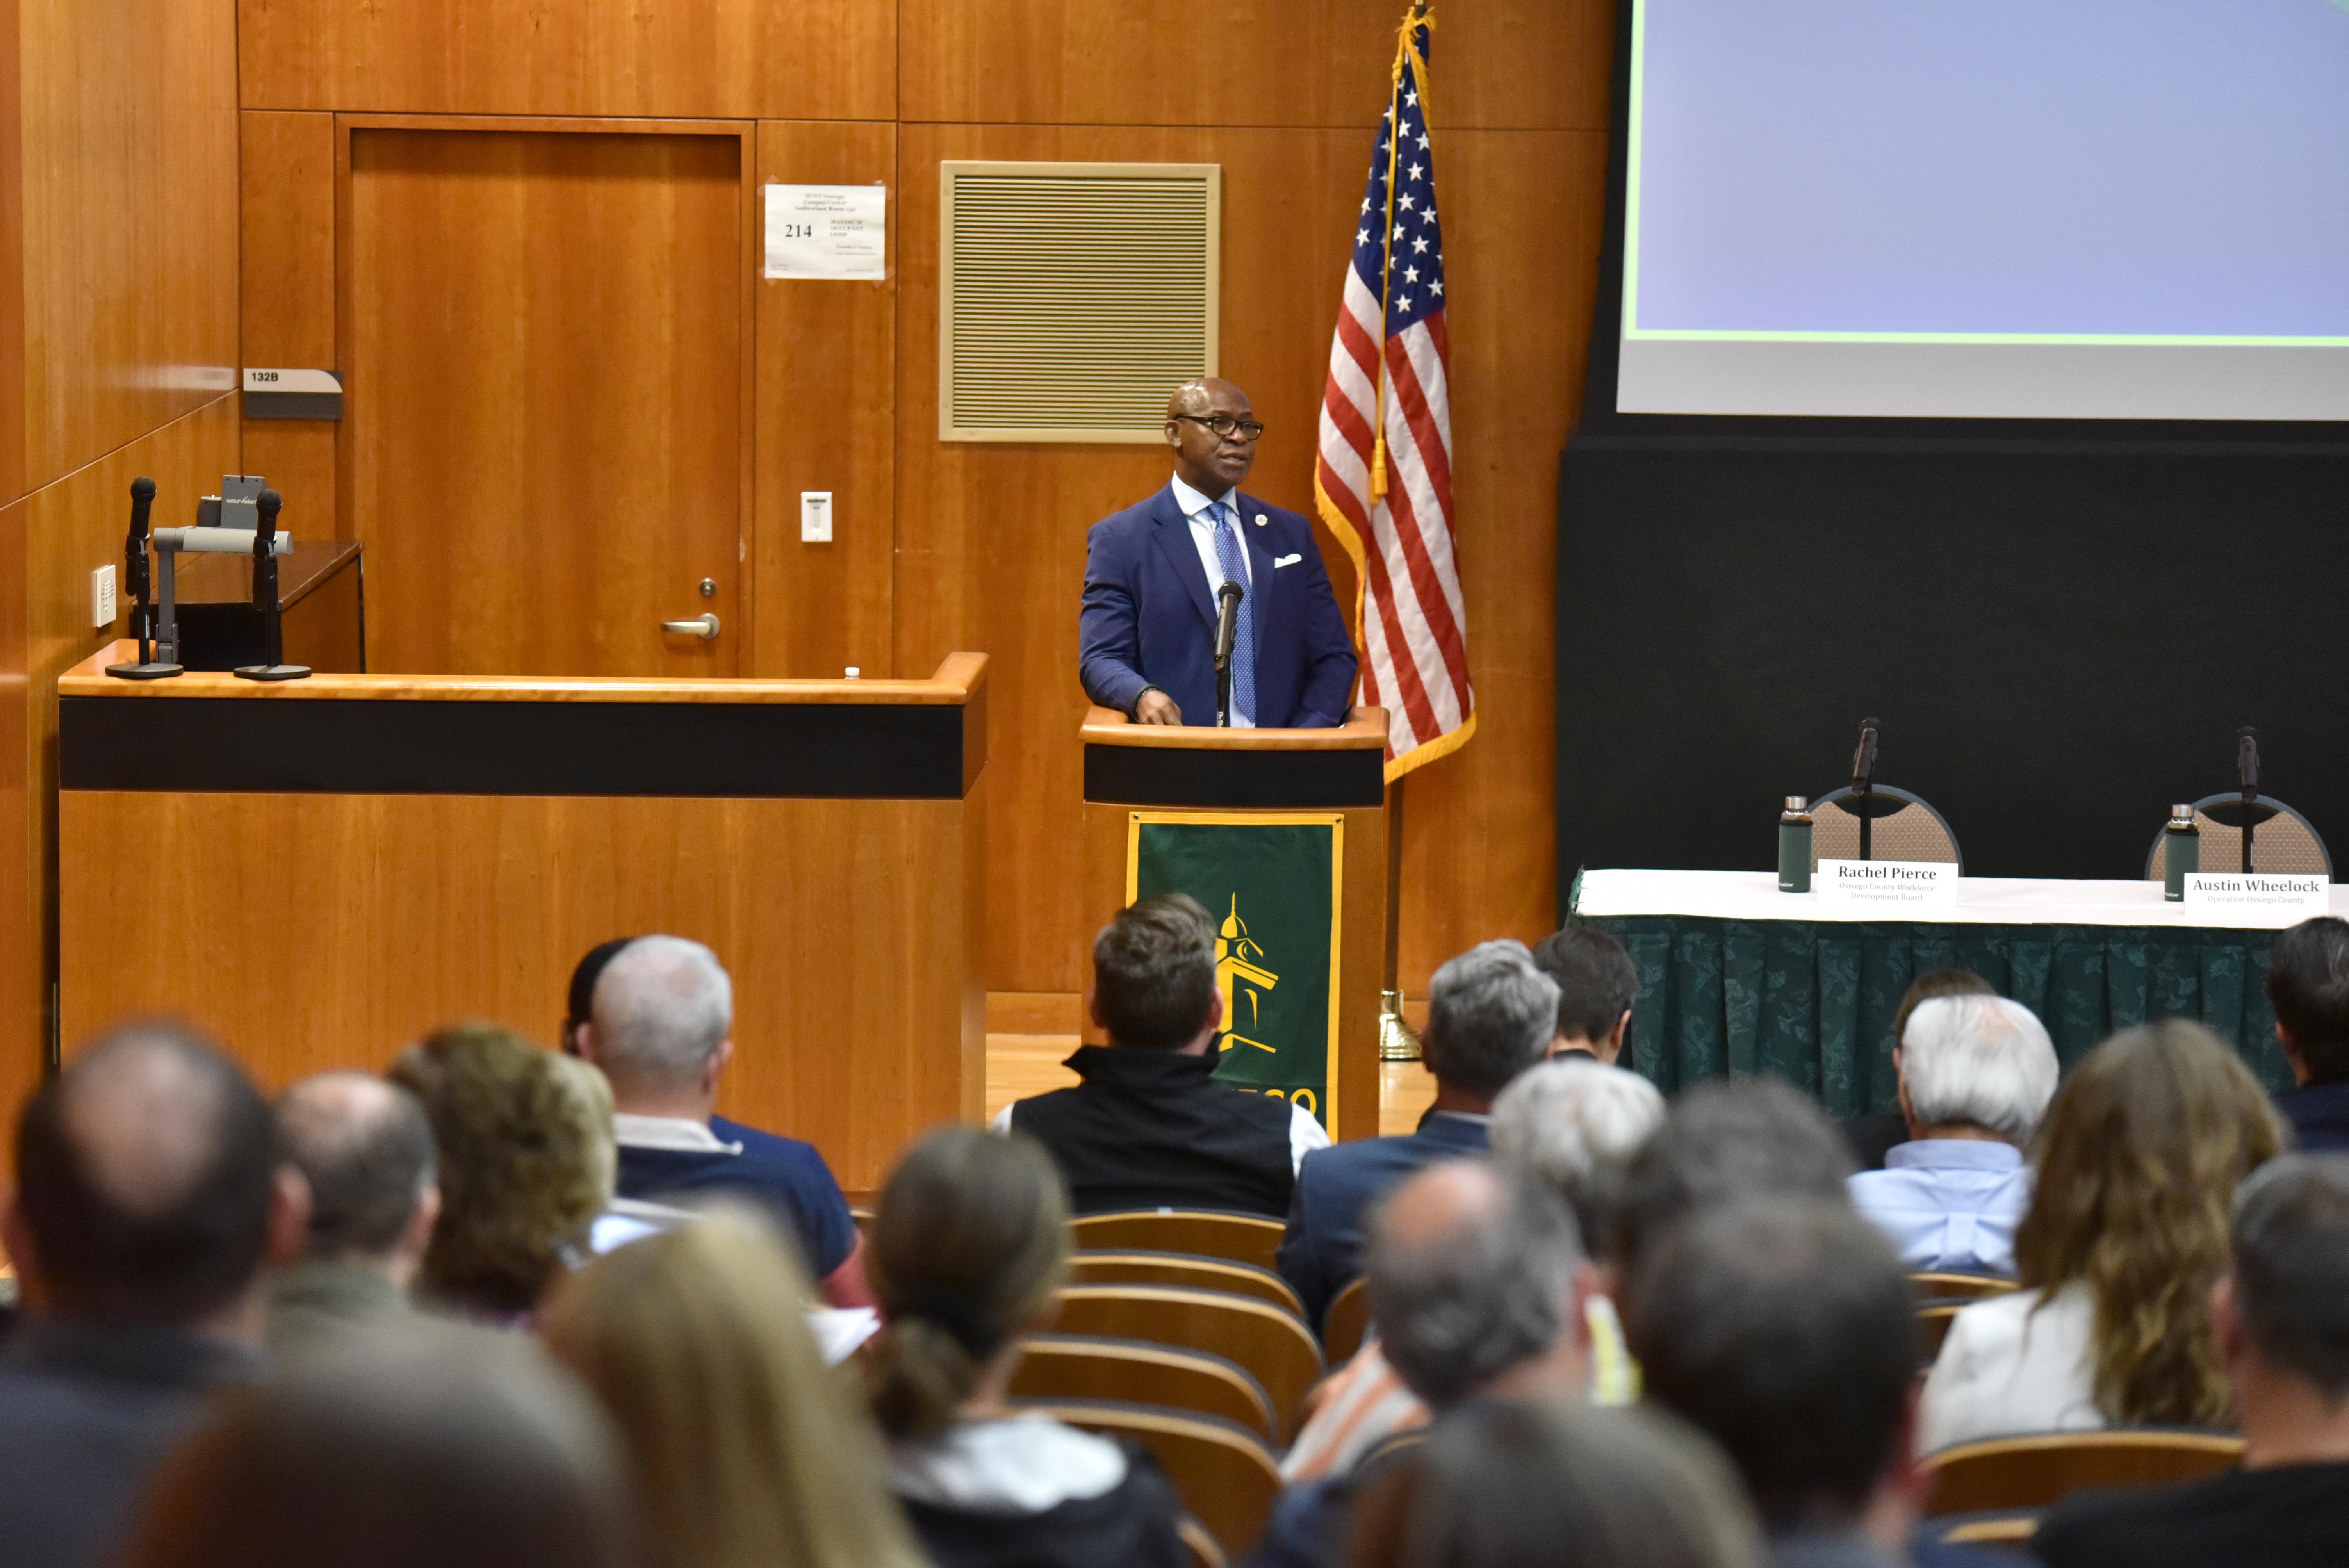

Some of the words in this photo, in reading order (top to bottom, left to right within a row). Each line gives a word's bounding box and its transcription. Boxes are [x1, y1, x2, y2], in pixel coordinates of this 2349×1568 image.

[785, 224, 812, 237] 214
[252, 372, 278, 381] 132B
[1839, 866, 1886, 878] Rachel
[1892, 867, 1937, 880] Pierce
[1870, 883, 1895, 891] County
[1897, 884, 1935, 892] Workforce
[2193, 879, 2240, 891] Austin
[2245, 880, 2320, 892] Wheelock
[1851, 893, 1899, 901] Development
[2208, 895, 2245, 903] Operation
[2247, 896, 2276, 905] Oswego
[2278, 896, 2305, 905] County
